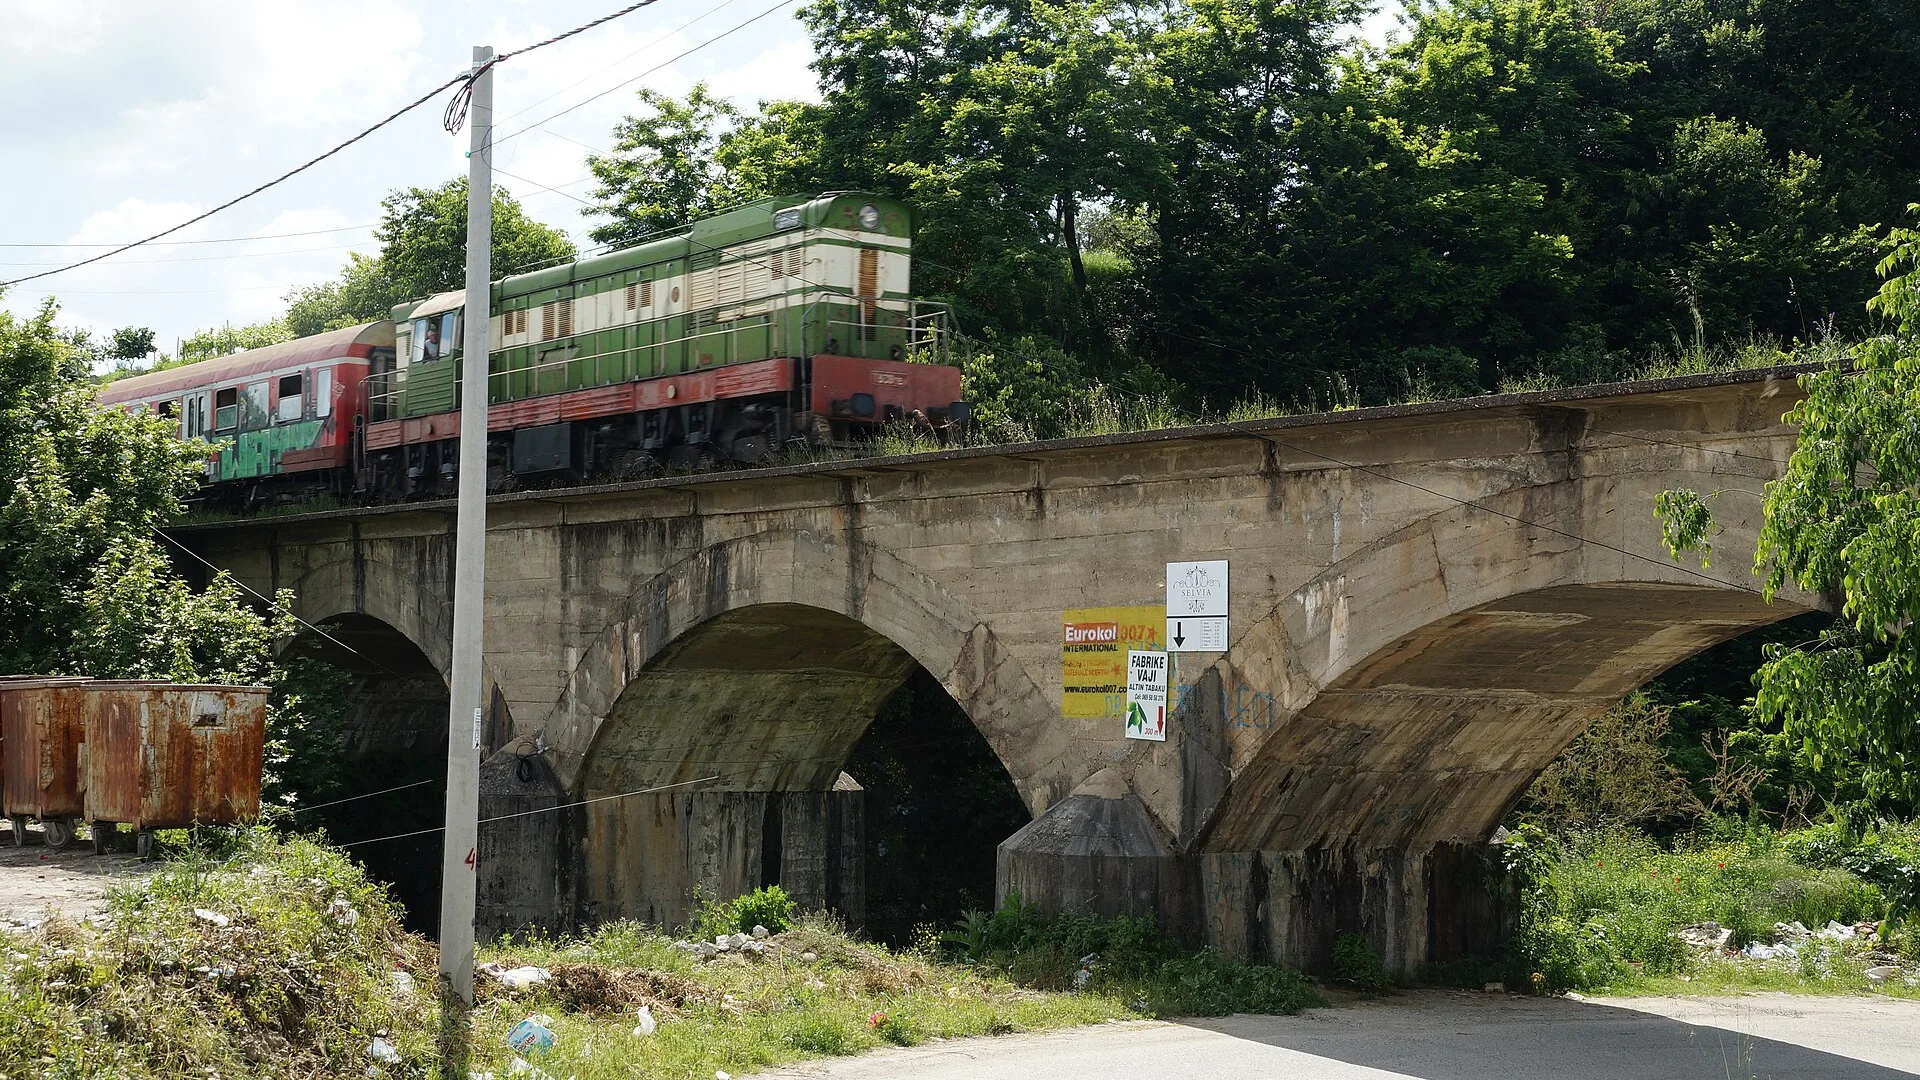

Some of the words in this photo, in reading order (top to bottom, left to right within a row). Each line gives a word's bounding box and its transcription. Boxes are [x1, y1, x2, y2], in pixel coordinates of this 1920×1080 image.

[1181, 589, 1212, 597] SELVIA
[1065, 625, 1117, 642] Eurokol
[1121, 625, 1146, 641] 007
[1063, 643, 1118, 653] INTERNATIONAL
[1131, 655, 1165, 669] FABRIKE
[1137, 669, 1157, 682] VAJI
[1064, 685, 1127, 694] www.eurokol007.co
[1129, 683, 1144, 691] ALTIN
[1145, 684, 1166, 693] TABAKU
[1144, 727, 1154, 735] 300
[464, 847, 476, 870] 4
